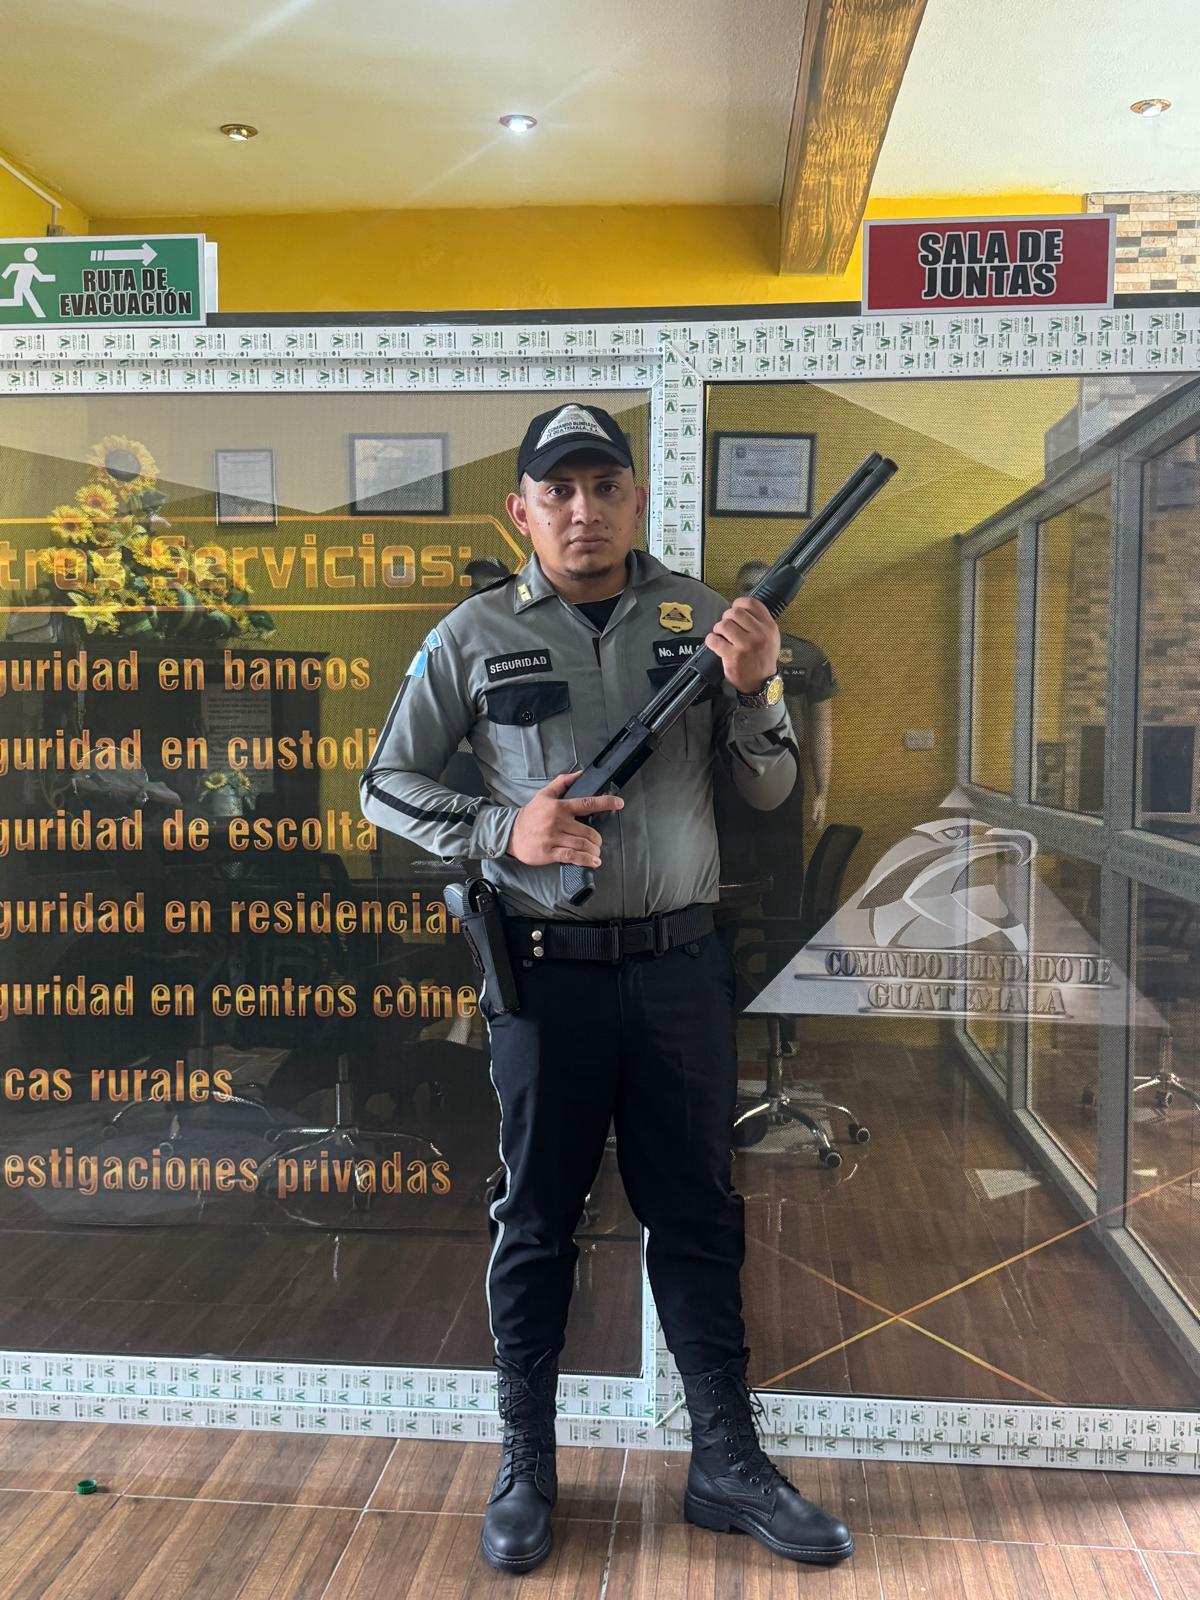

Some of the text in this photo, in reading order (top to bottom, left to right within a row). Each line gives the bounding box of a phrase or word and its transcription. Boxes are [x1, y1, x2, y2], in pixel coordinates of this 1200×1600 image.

[919, 229, 1063, 266] SALA DE
[82, 268, 167, 292] RUTA DE
[922, 264, 1056, 298] JUNTAS
[60, 288, 192, 317] EVACUACIÓN
[151, 535, 472, 588] Servicios:
[490, 656, 547, 673] SEGURIDAD
[658, 647, 675, 657] No.
[158, 657, 205, 691] en
[224, 651, 370, 691] bancos
[161, 736, 208, 770] en
[162, 810, 210, 851] de
[228, 809, 377, 852] escolta
[165, 900, 211, 933] en
[825, 951, 942, 978] COMANDO
[1079, 958, 1112, 984] DE
[151, 984, 194, 1017] en
[212, 977, 357, 1017] centros
[373, 985, 477, 1017] come
[868, 983, 1066, 1015] GUATEMALA
[5, 1061, 233, 1101] cas rurales
[5, 1147, 451, 1199] estigaciones privadas
